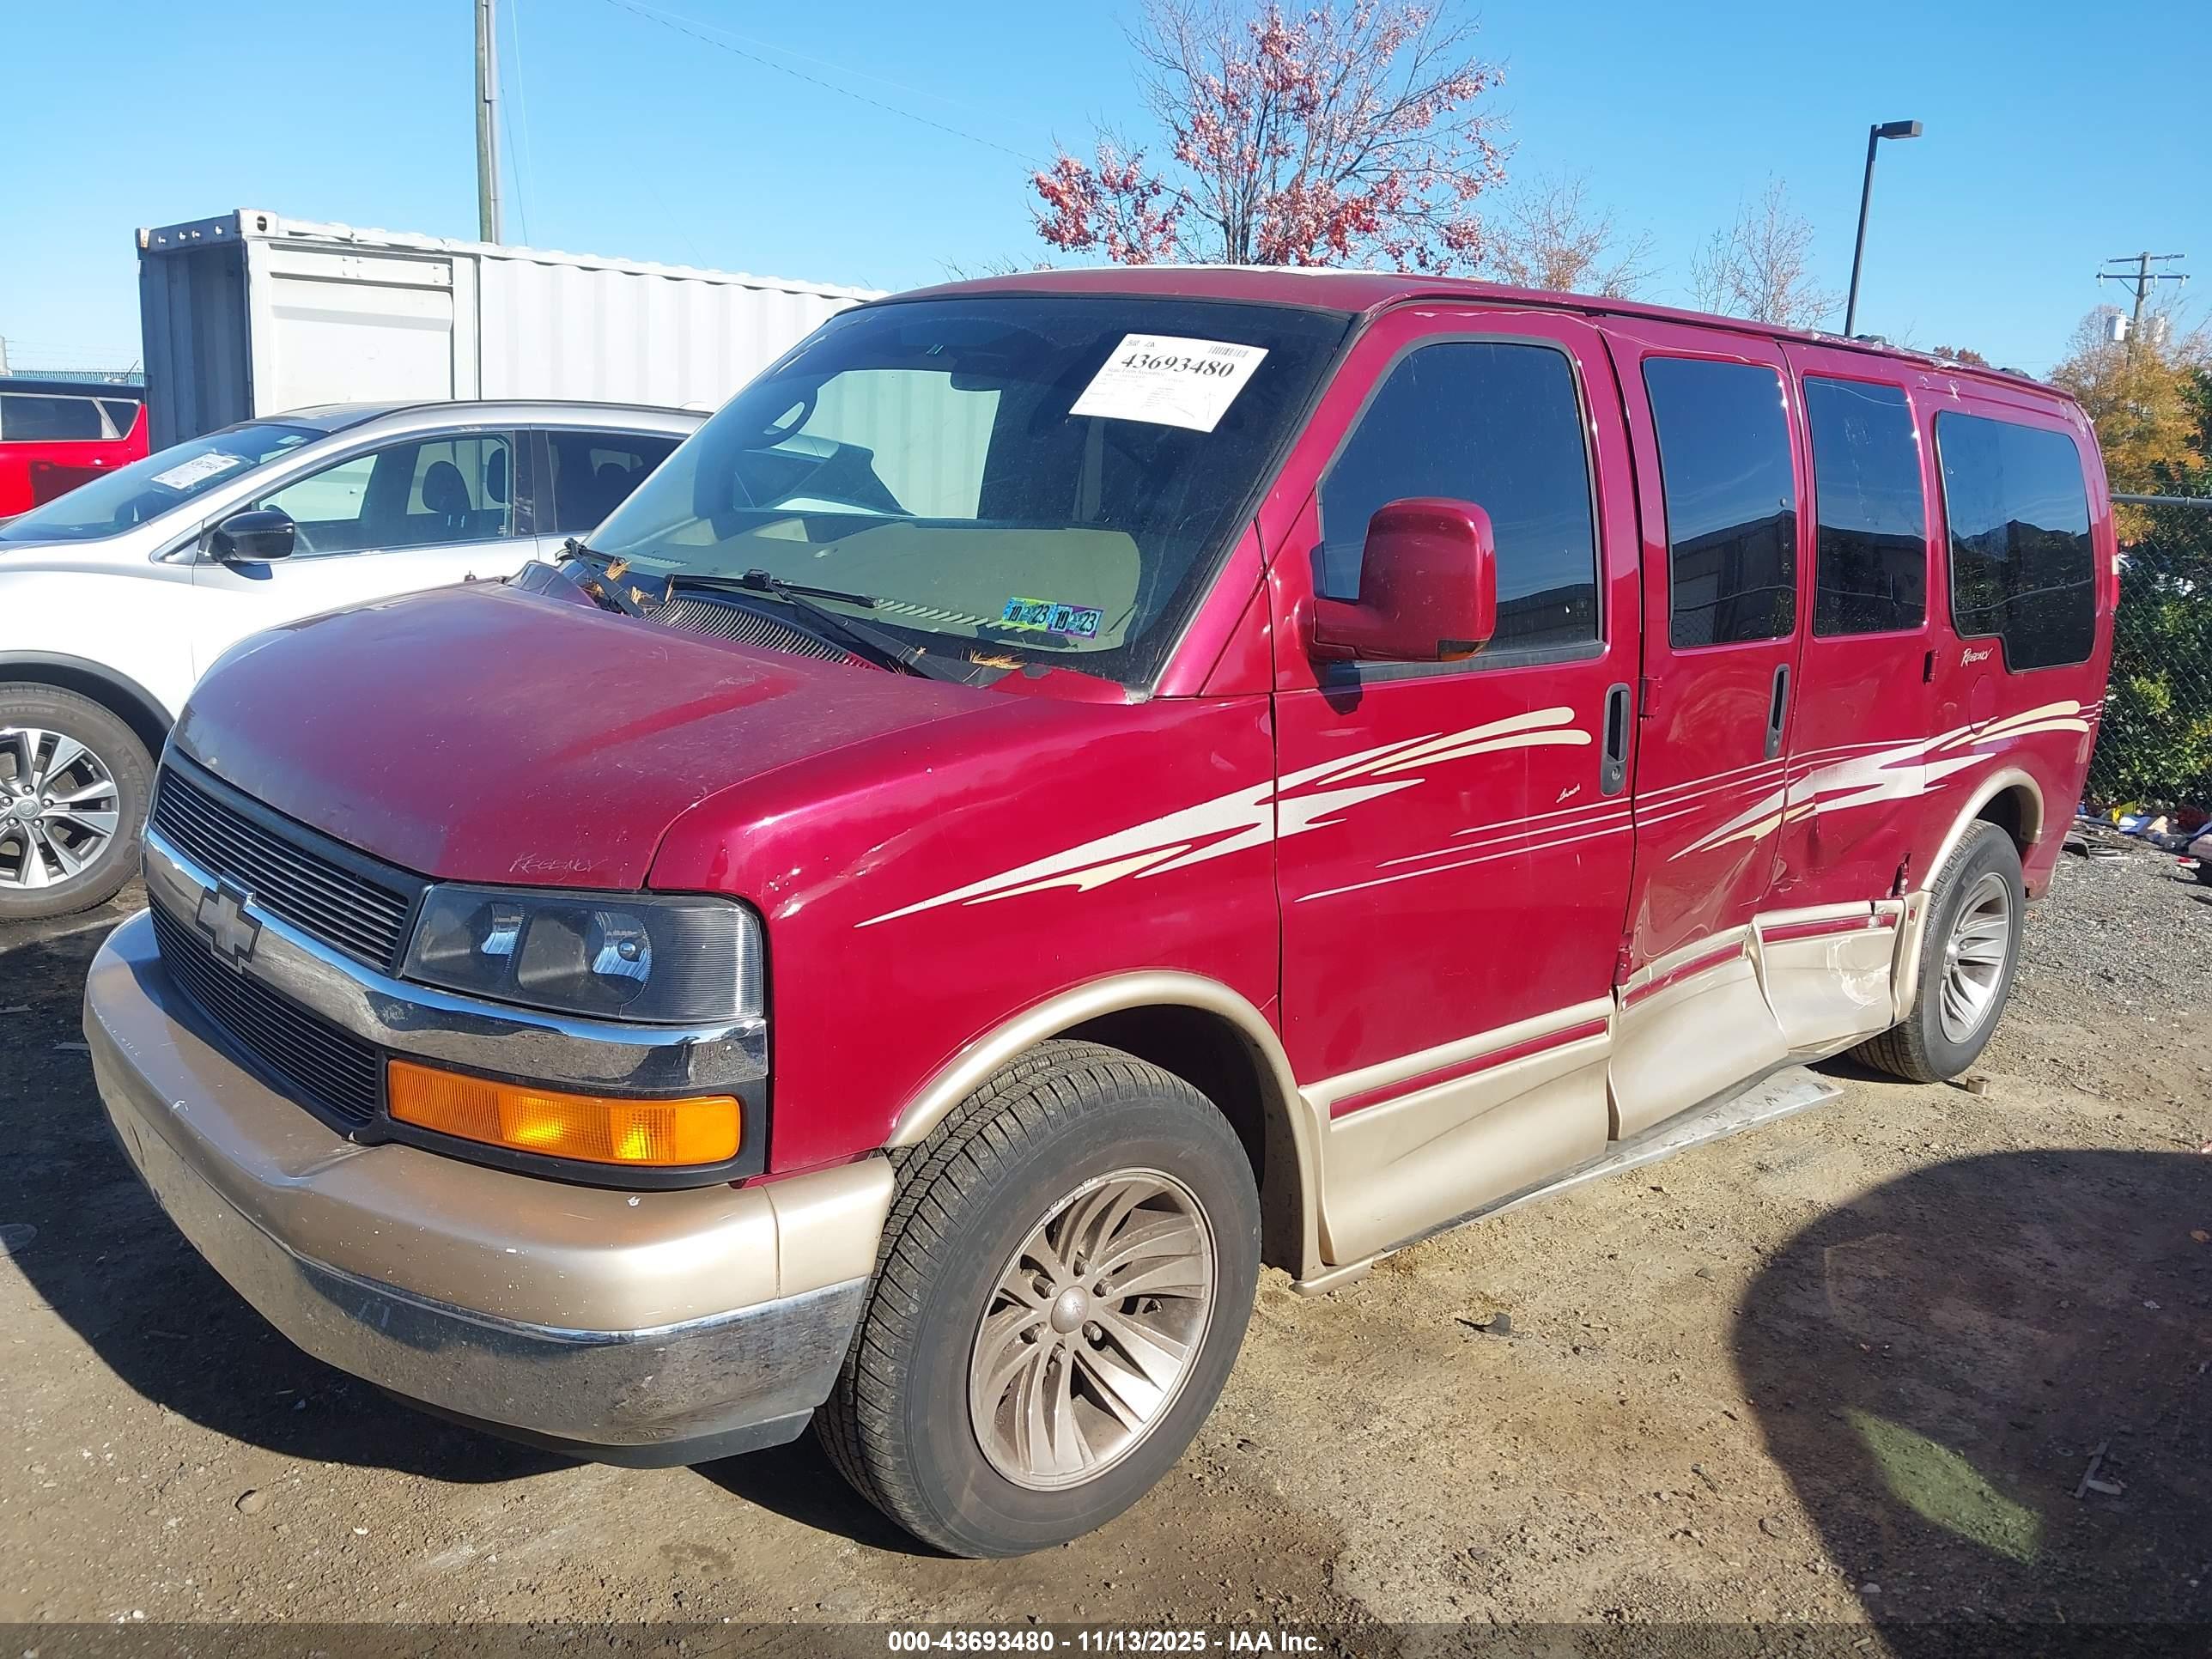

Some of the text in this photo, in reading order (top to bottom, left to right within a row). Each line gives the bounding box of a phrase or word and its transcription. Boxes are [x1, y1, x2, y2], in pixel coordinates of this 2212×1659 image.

[1121, 353, 1235, 378] 43693480
[1009, 604, 1050, 624] 10 23
[1054, 609, 1097, 633] 10 23
